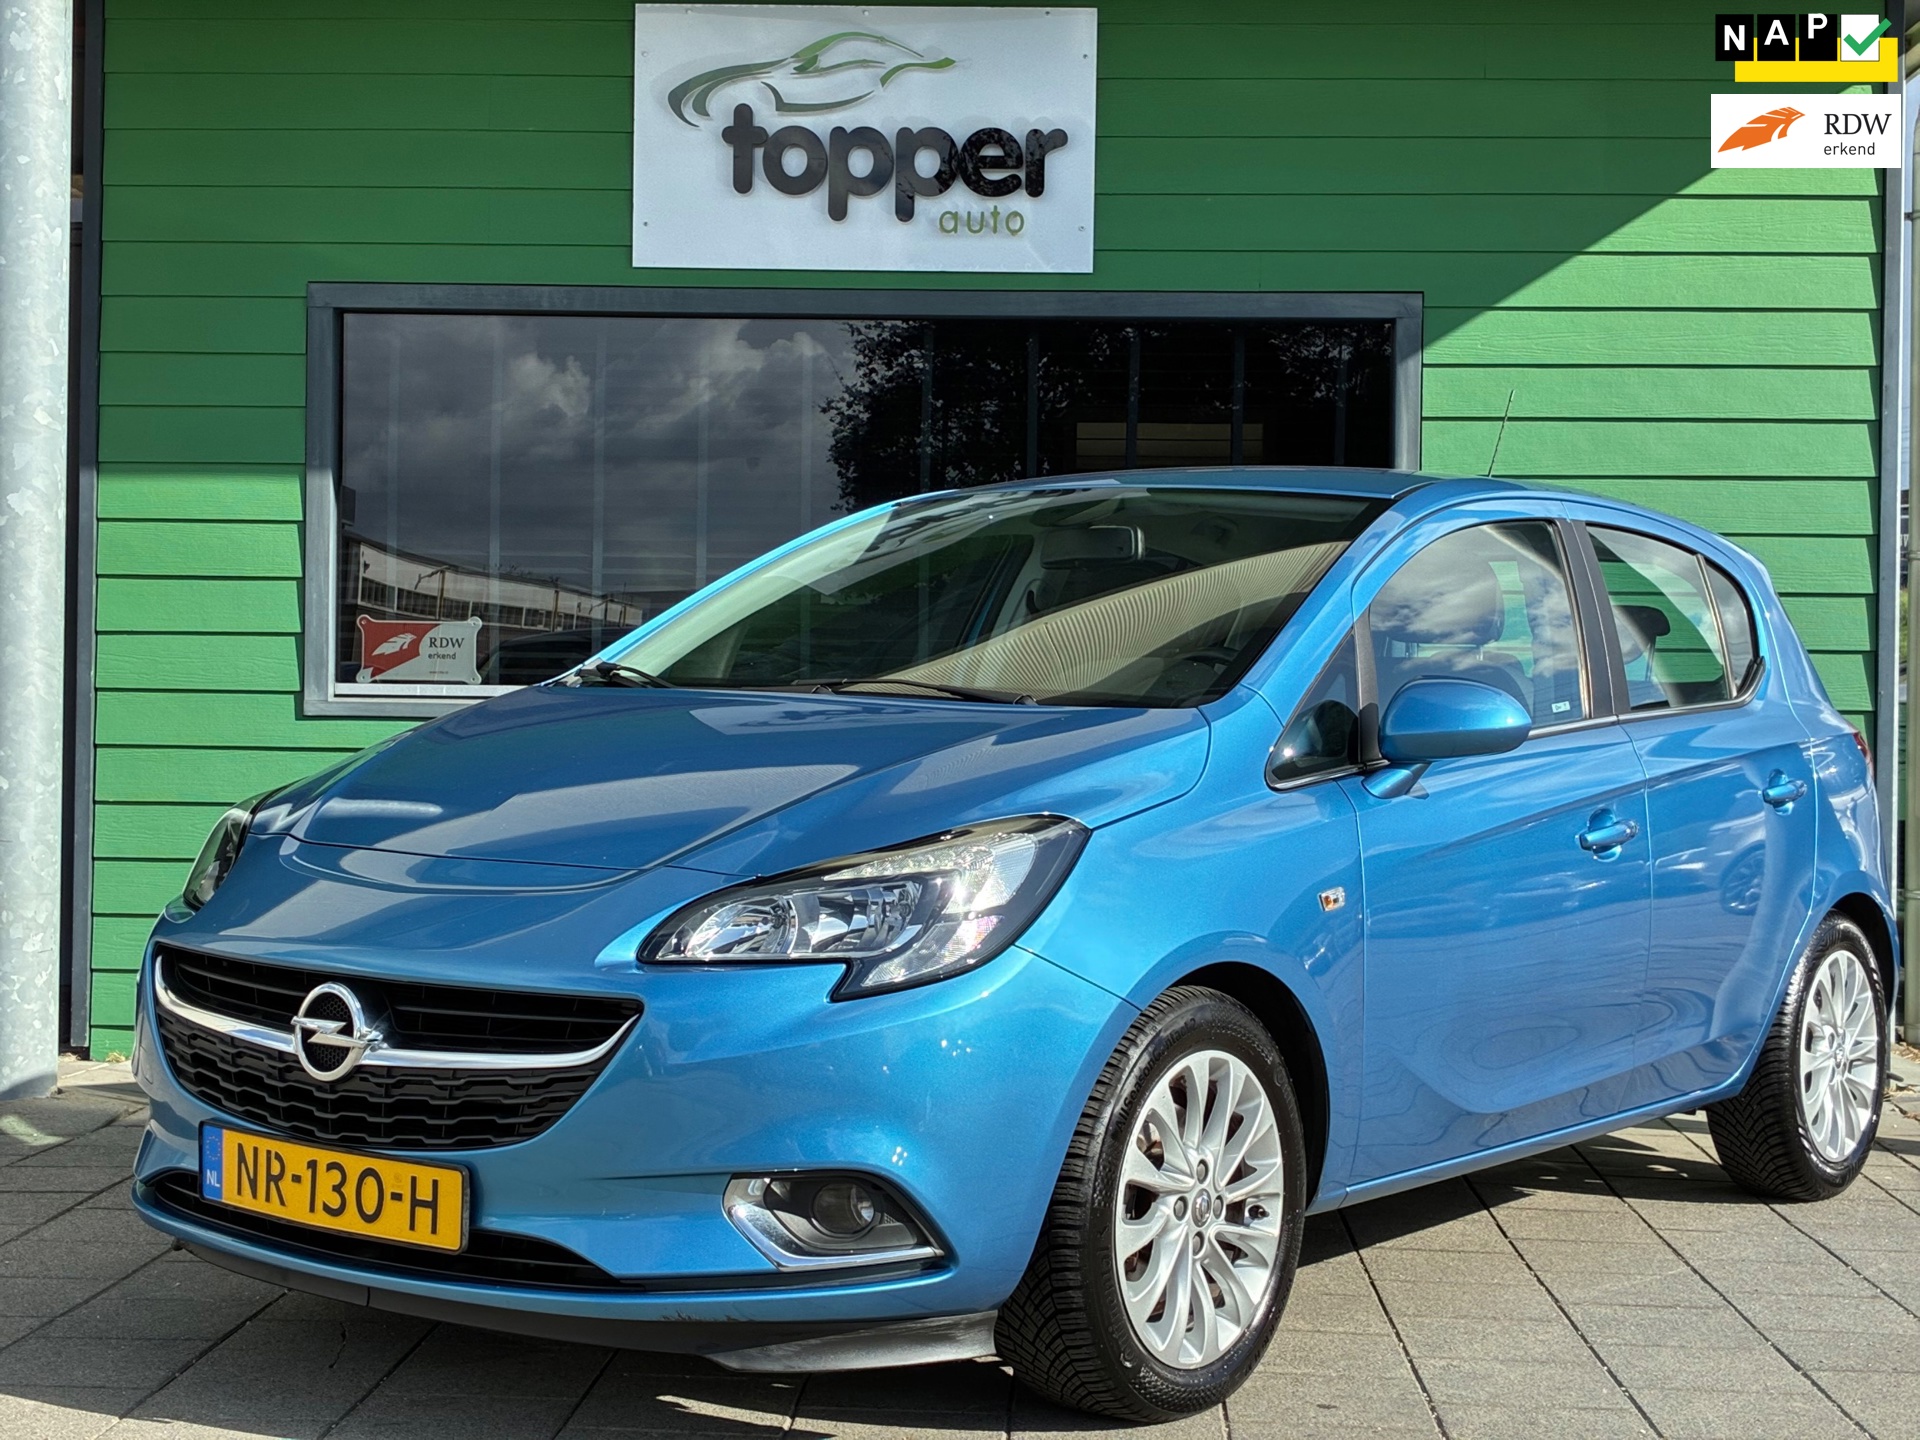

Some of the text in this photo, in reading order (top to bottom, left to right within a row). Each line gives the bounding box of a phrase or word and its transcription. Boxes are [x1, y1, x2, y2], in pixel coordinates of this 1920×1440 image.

[722, 103, 1069, 222] topper
[939, 205, 1025, 236] auto
[429, 637, 464, 648] RDW
[428, 652, 457, 660] erkend
[206, 1169, 220, 1188] NL
[237, 1142, 439, 1235] NR-130-H
